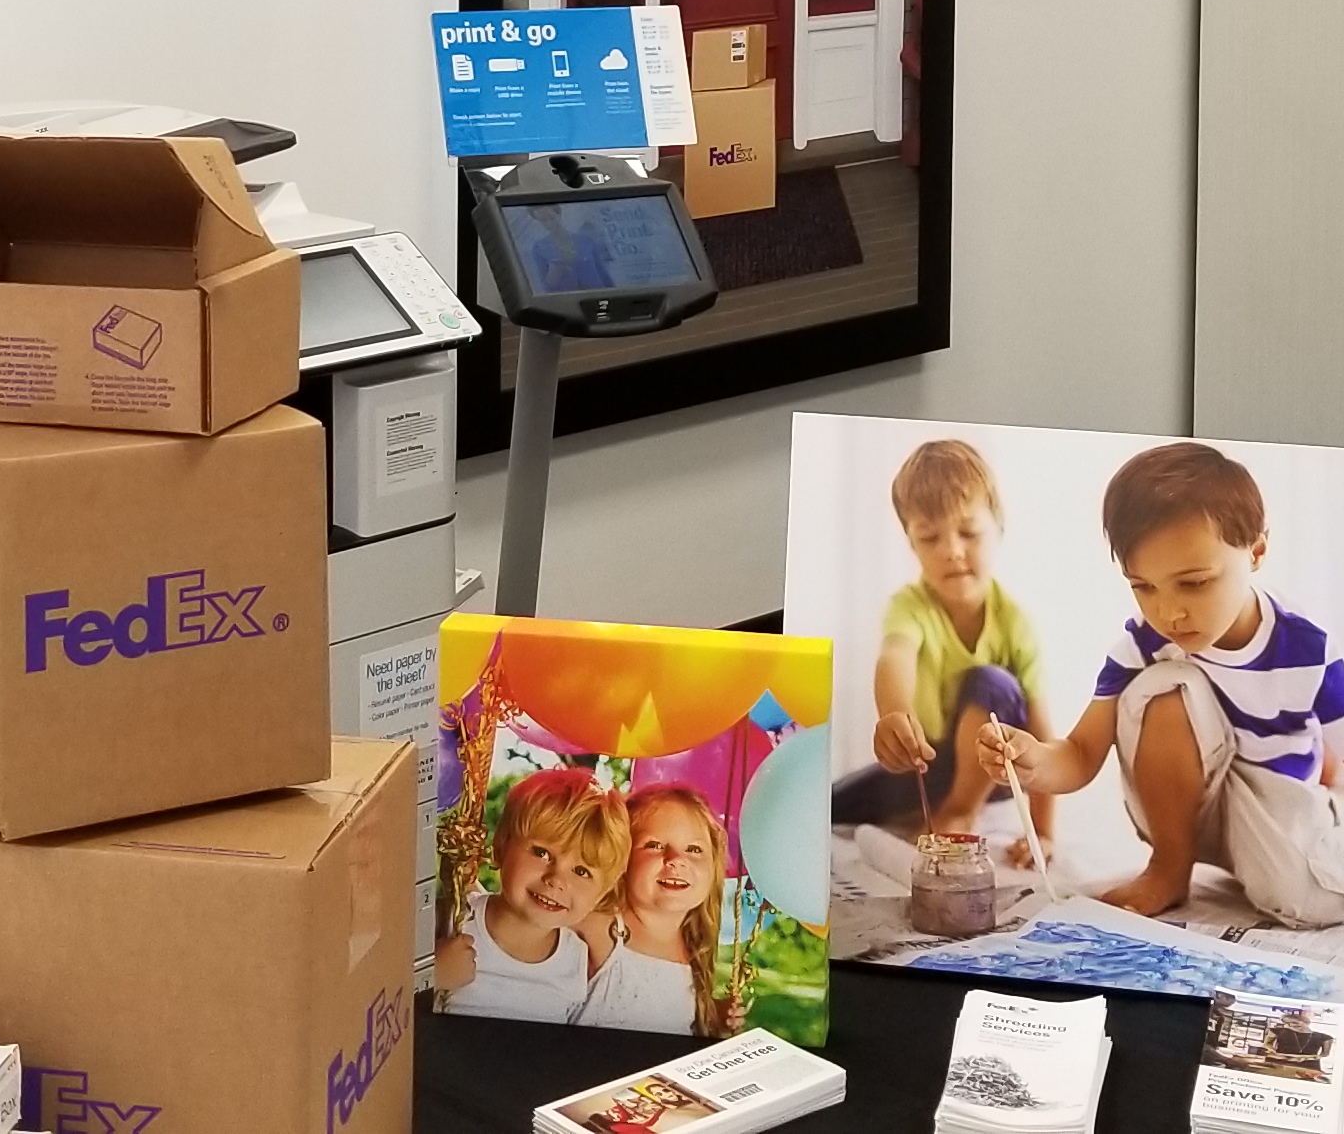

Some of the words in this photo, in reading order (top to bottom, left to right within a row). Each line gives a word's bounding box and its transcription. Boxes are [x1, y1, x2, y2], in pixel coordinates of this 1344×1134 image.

[441, 21, 496, 49] print
[501, 19, 522, 42] &
[527, 23, 556, 46] go
[366, 656, 394, 679] Need
[396, 651, 423, 670] paper
[425, 646, 437, 663] by
[376, 676, 393, 694] the
[395, 664, 427, 688] sheet?
[982, 1021, 1051, 1038] Services
[686, 1066, 714, 1081] Get
[713, 1056, 745, 1071] One
[742, 1044, 778, 1060] Free
[1205, 1083, 1265, 1102] Save
[1274, 1095, 1324, 1112] 10%
